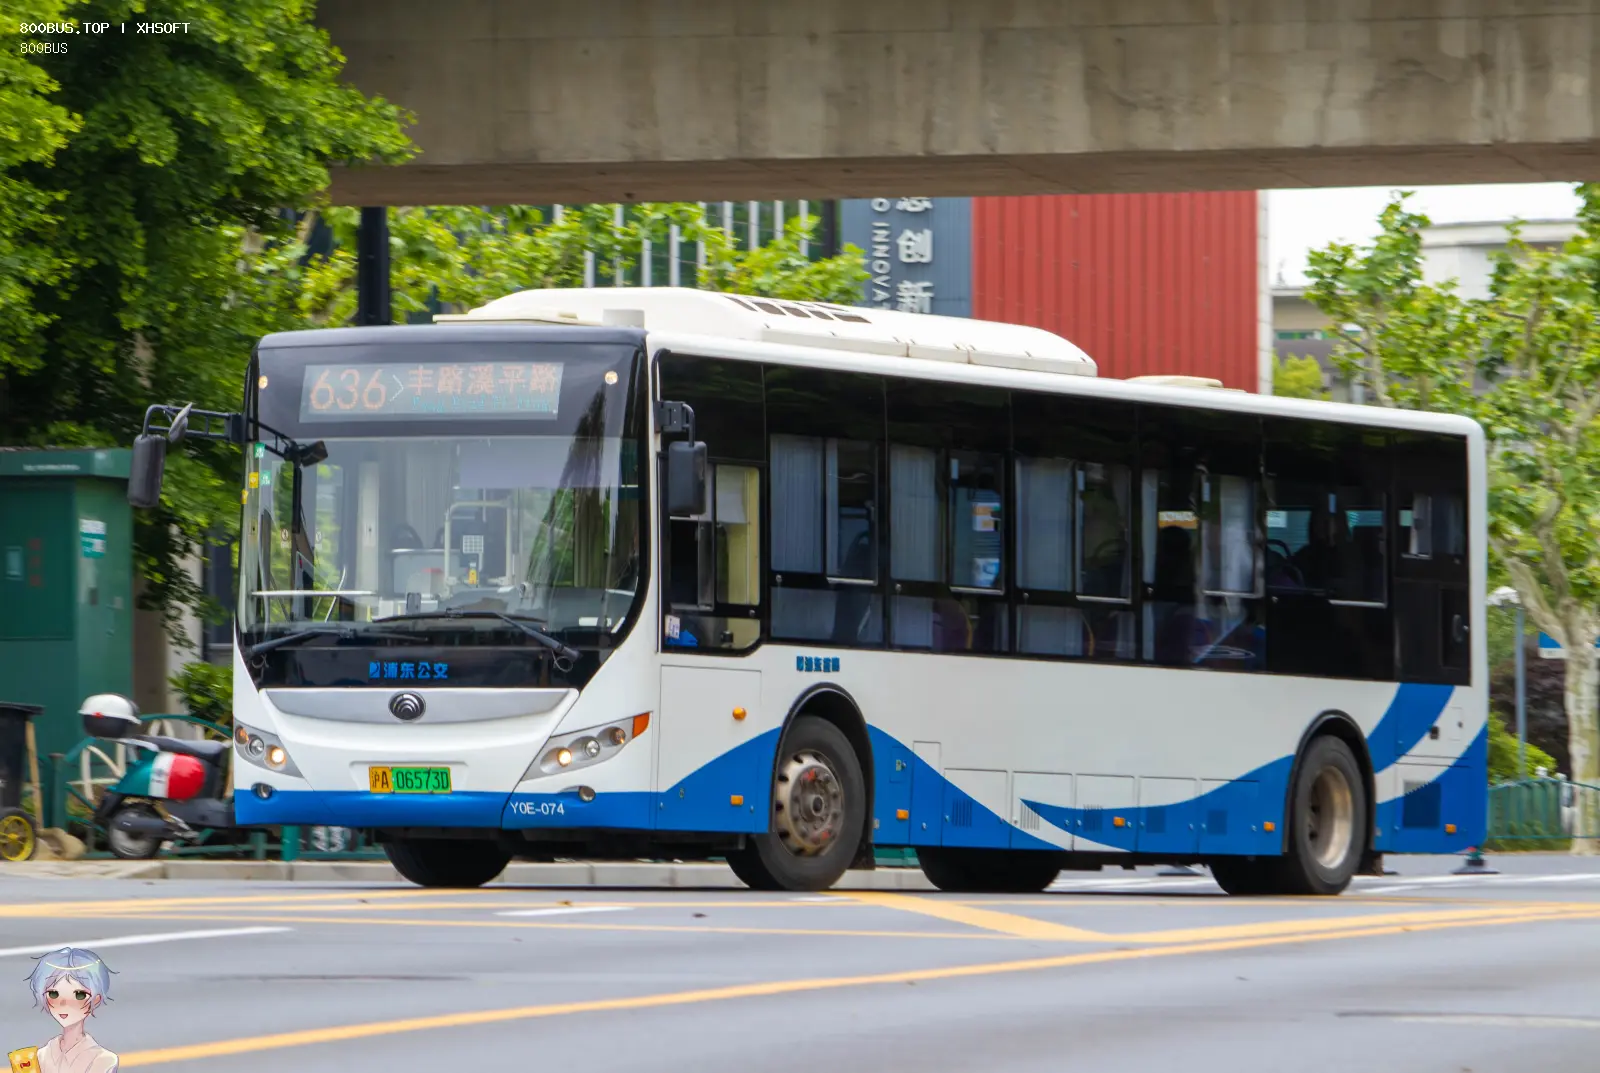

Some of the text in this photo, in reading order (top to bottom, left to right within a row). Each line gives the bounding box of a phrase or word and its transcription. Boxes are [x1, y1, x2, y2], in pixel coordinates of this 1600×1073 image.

[310, 368, 387, 411] 636
[383, 661, 449, 679] 浦东公交
